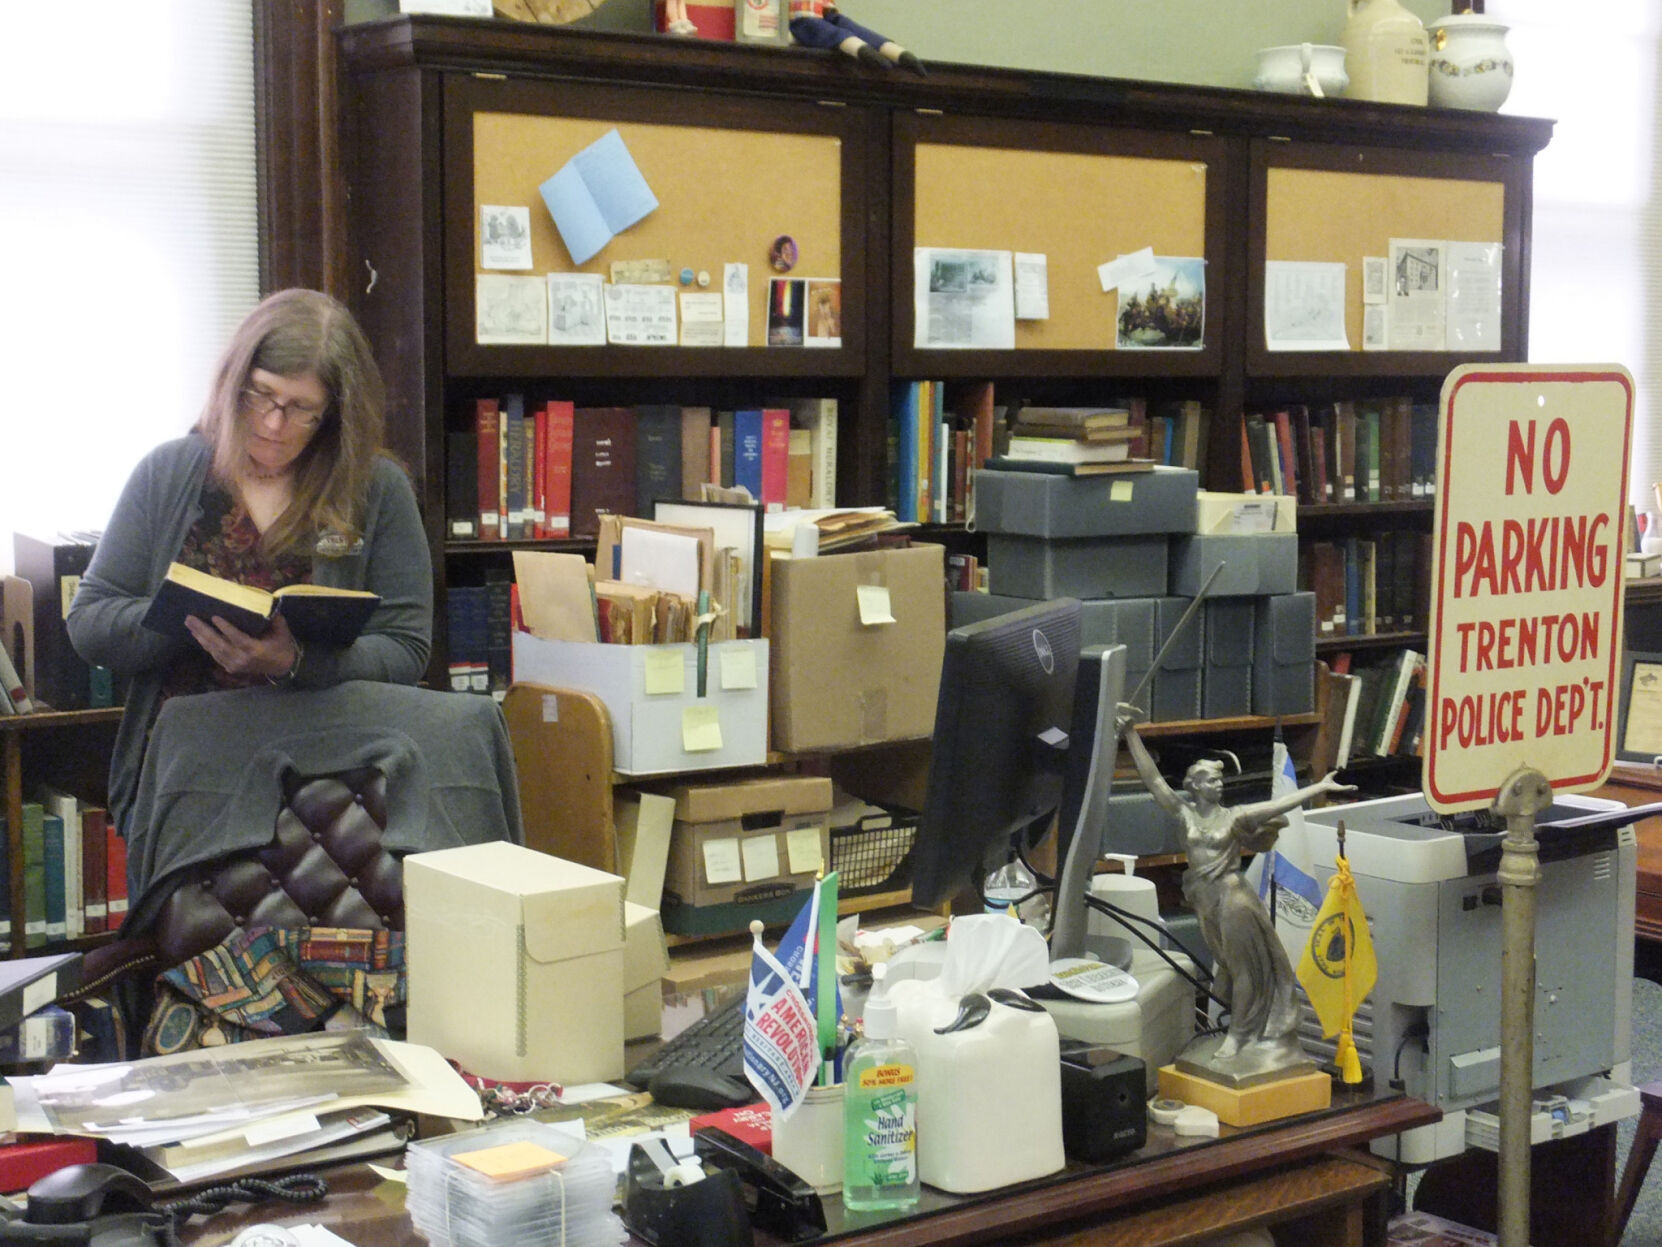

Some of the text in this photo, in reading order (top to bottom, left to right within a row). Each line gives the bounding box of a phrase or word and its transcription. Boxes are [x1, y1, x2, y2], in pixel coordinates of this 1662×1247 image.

[1505, 417, 1571, 495] NO
[1453, 513, 1609, 598] PARKING
[1457, 611, 1599, 673] TRENTON
[1440, 676, 1604, 750] POLICE DEP'T.
[867, 1130, 914, 1147] Sanitizer
[878, 1114, 904, 1131] Hand
